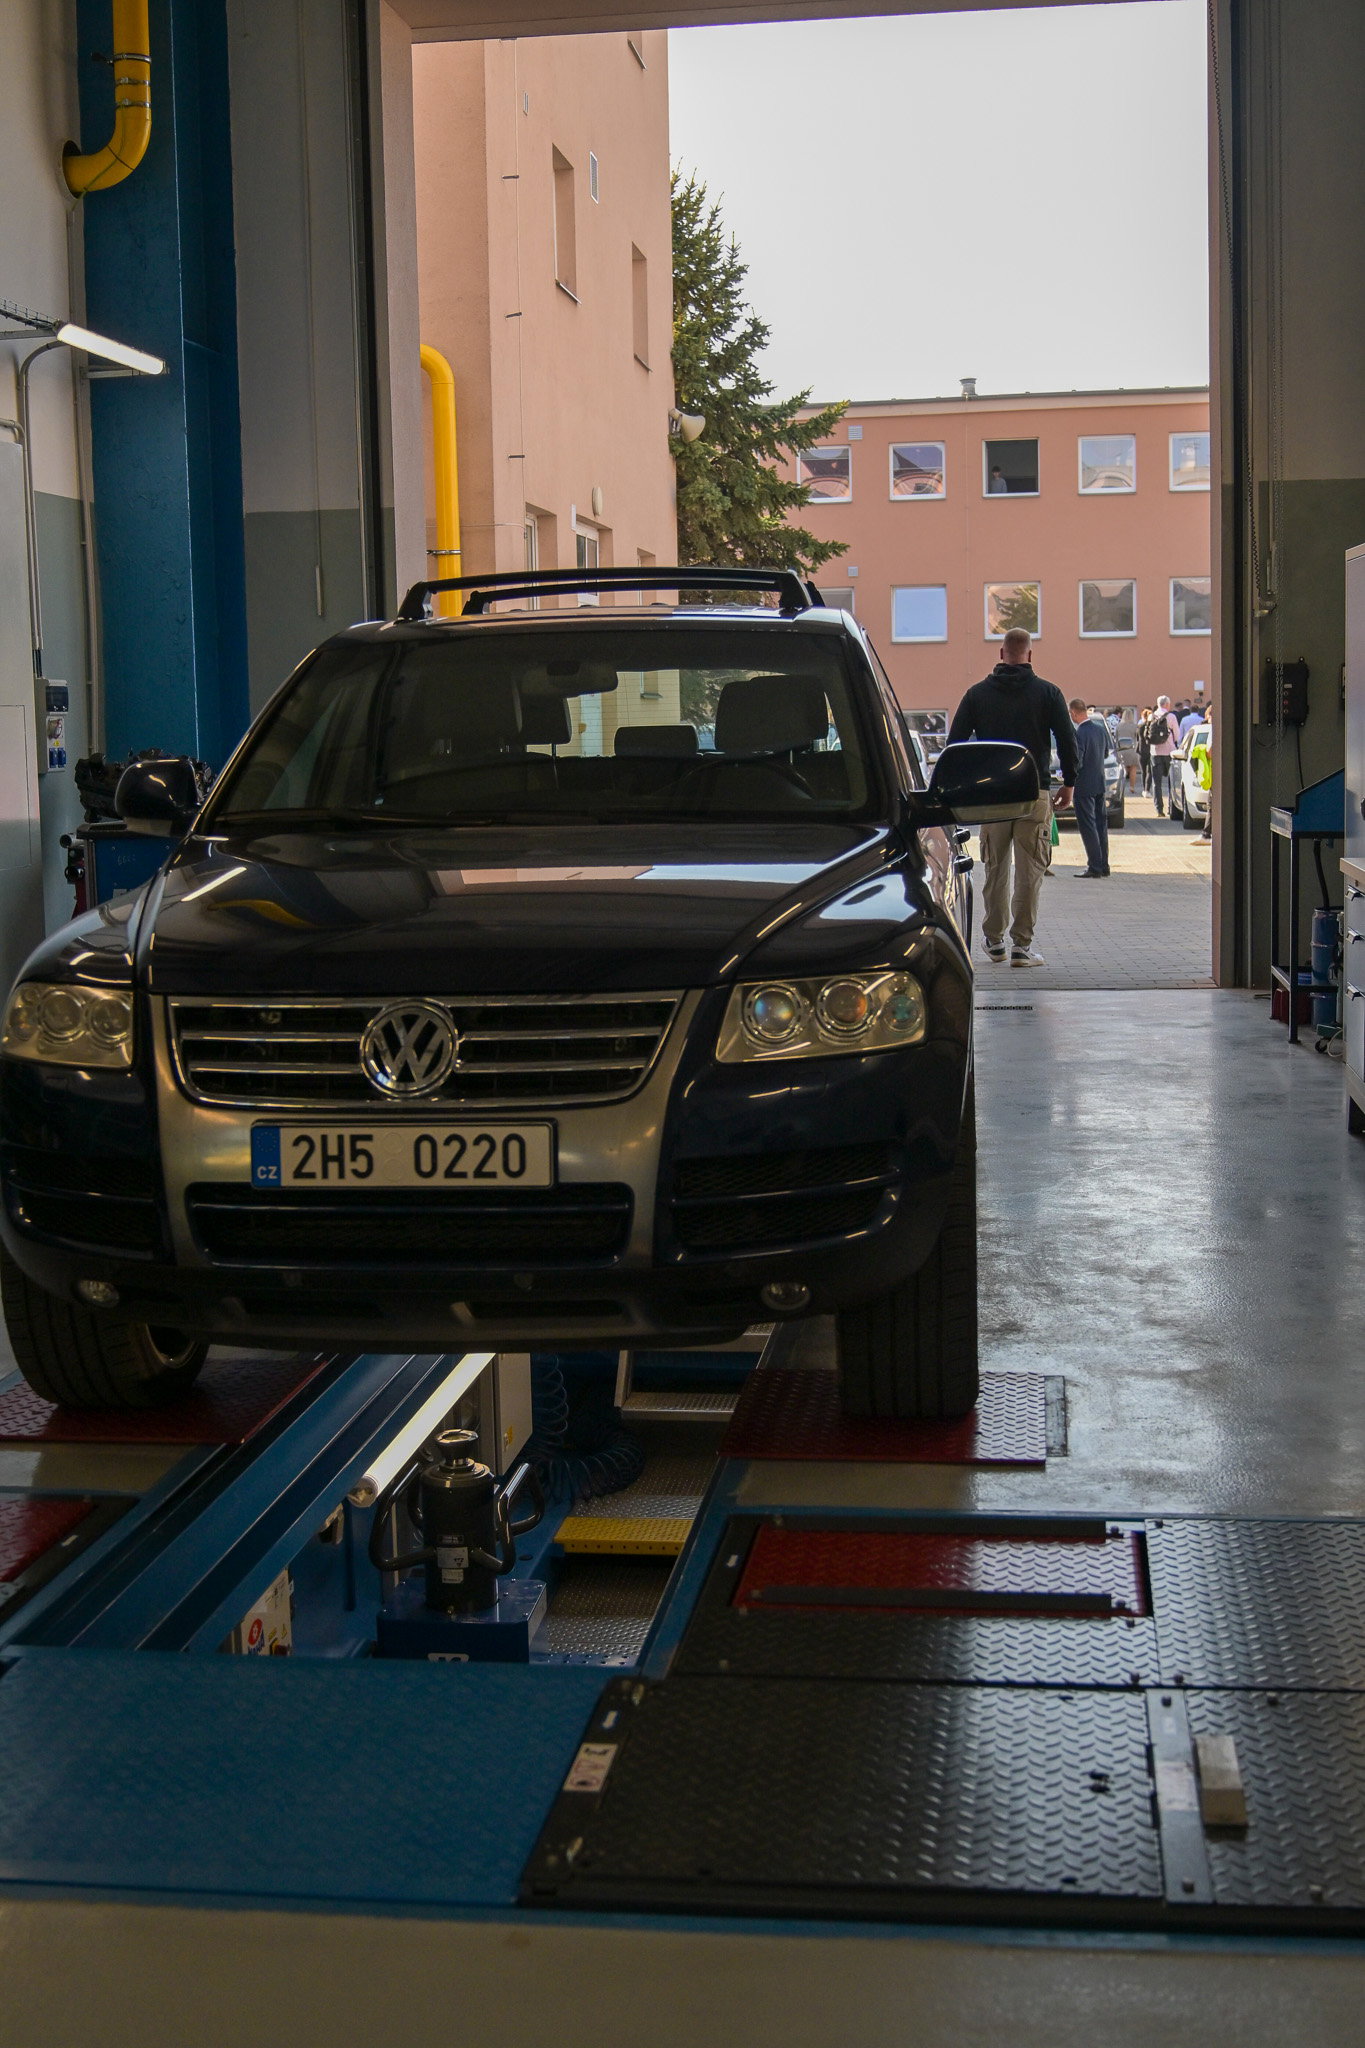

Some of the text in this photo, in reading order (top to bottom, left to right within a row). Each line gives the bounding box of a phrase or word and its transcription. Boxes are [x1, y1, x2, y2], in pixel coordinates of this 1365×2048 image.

[292, 1133, 527, 1180] 2H5 0220
[257, 1166, 278, 1179] CZ
